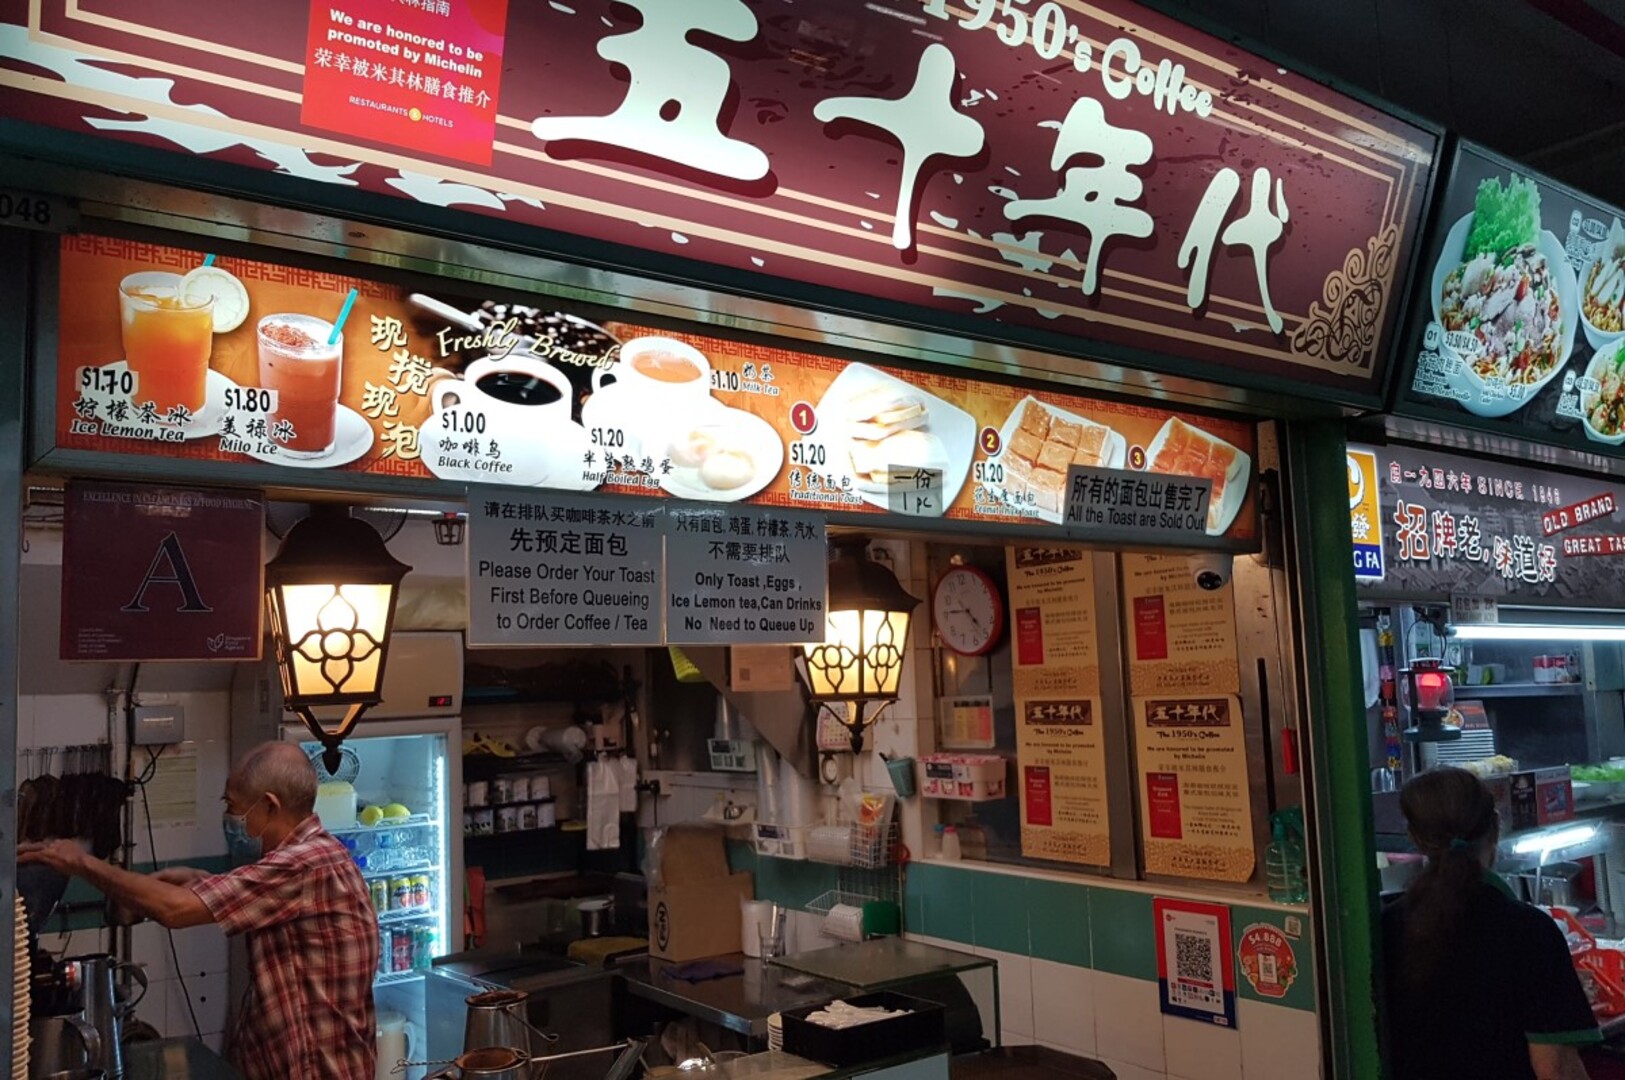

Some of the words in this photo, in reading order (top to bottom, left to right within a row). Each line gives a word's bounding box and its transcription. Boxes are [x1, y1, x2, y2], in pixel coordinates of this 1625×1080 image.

[330, 9, 353, 26] We
[357, 18, 382, 34] are
[386, 24, 445, 51] honored
[448, 42, 462, 56] to
[466, 46, 484, 62] be
[327, 28, 399, 56] promoted
[403, 47, 421, 64] by
[424, 51, 483, 79] Michelin
[313, 47, 492, 109] 荣幸被米其林膳食推介
[1102, 38, 1213, 117] Coffee
[348, 95, 408, 117] RESTAURANTS
[422, 114, 454, 128] HOTELS
[532, 0, 1288, 334] 五十年代
[436, 317, 519, 360] Freshly
[528, 332, 622, 371] Brewed
[1427, 330, 1437, 341] 01
[82, 367, 133, 395] $1.70
[711, 370, 739, 391] $1.10
[743, 363, 775, 381] 奶茶
[741, 381, 761, 392] Milk
[764, 384, 779, 395] Tea
[224, 388, 270, 412] $1.80
[74, 397, 192, 427] 柠檬茶冰
[442, 410, 486, 434] $1.00
[799, 410, 808, 426] 1
[71, 421, 97, 433] Ice
[102, 421, 154, 438] Lemon
[158, 427, 185, 441] Tea
[219, 415, 297, 441] 美禄冰
[591, 427, 624, 447] $1.20
[220, 438, 252, 452] Milo
[256, 442, 278, 454] Ice
[986, 434, 995, 448] 2
[438, 456, 471, 470] Black
[474, 458, 513, 473] Coffee
[582, 449, 675, 475] 半生熟鸡蛋
[792, 443, 826, 465] $1.20
[1134, 451, 1141, 464] 3
[582, 471, 605, 485] Half
[607, 473, 640, 483] Boiled
[641, 475, 661, 487] Egg
[789, 470, 853, 492] 传统面包
[894, 468, 936, 489] 一份
[975, 463, 1003, 483] $1.20
[790, 489, 838, 501] Traditional
[840, 493, 864, 505] Toast
[1071, 475, 1207, 512] 所有的面包出售完了
[1477, 476, 1524, 500] SINCE
[484, 501, 655, 529] 请在排队买咖啡茶水之前
[917, 497, 932, 514] pc
[1067, 505, 1083, 522] All
[1085, 507, 1103, 523] the
[1107, 508, 1137, 526] Toast
[1140, 514, 1156, 527] are
[1159, 512, 1184, 529] Sold
[1186, 514, 1205, 531] Out
[1543, 511, 1569, 533] OLD
[510, 527, 628, 557] 先预定面包
[708, 541, 790, 563] 不需要排队
[1563, 538, 1602, 554] GREAT
[1365, 552, 1380, 569] FA
[120, 531, 214, 613] A
[478, 561, 531, 578] Please
[536, 563, 579, 580] Order
[583, 565, 616, 582] Your
[619, 567, 655, 583] Toast
[695, 572, 724, 589] Only
[727, 573, 760, 588] Toast
[490, 586, 524, 604] First
[530, 588, 577, 605] Before
[582, 589, 649, 610] Queueing
[671, 593, 690, 607] Ice
[694, 594, 735, 608] Lemon
[786, 597, 822, 611] Drinks
[497, 614, 512, 629] to
[517, 612, 559, 630] Order
[564, 613, 611, 630] Coffee
[624, 614, 648, 630] Tea
[684, 616, 702, 630] No
[710, 617, 740, 631] Need
[744, 618, 756, 631] to
[759, 617, 796, 632] Queue
[799, 618, 815, 634] Up
[1032, 704, 1084, 721] 五十年代
[1153, 704, 1221, 722] 五十年代
[1156, 731, 1170, 739] The
[1172, 730, 1197, 738] 1950's
[1199, 731, 1221, 739] Coffee
